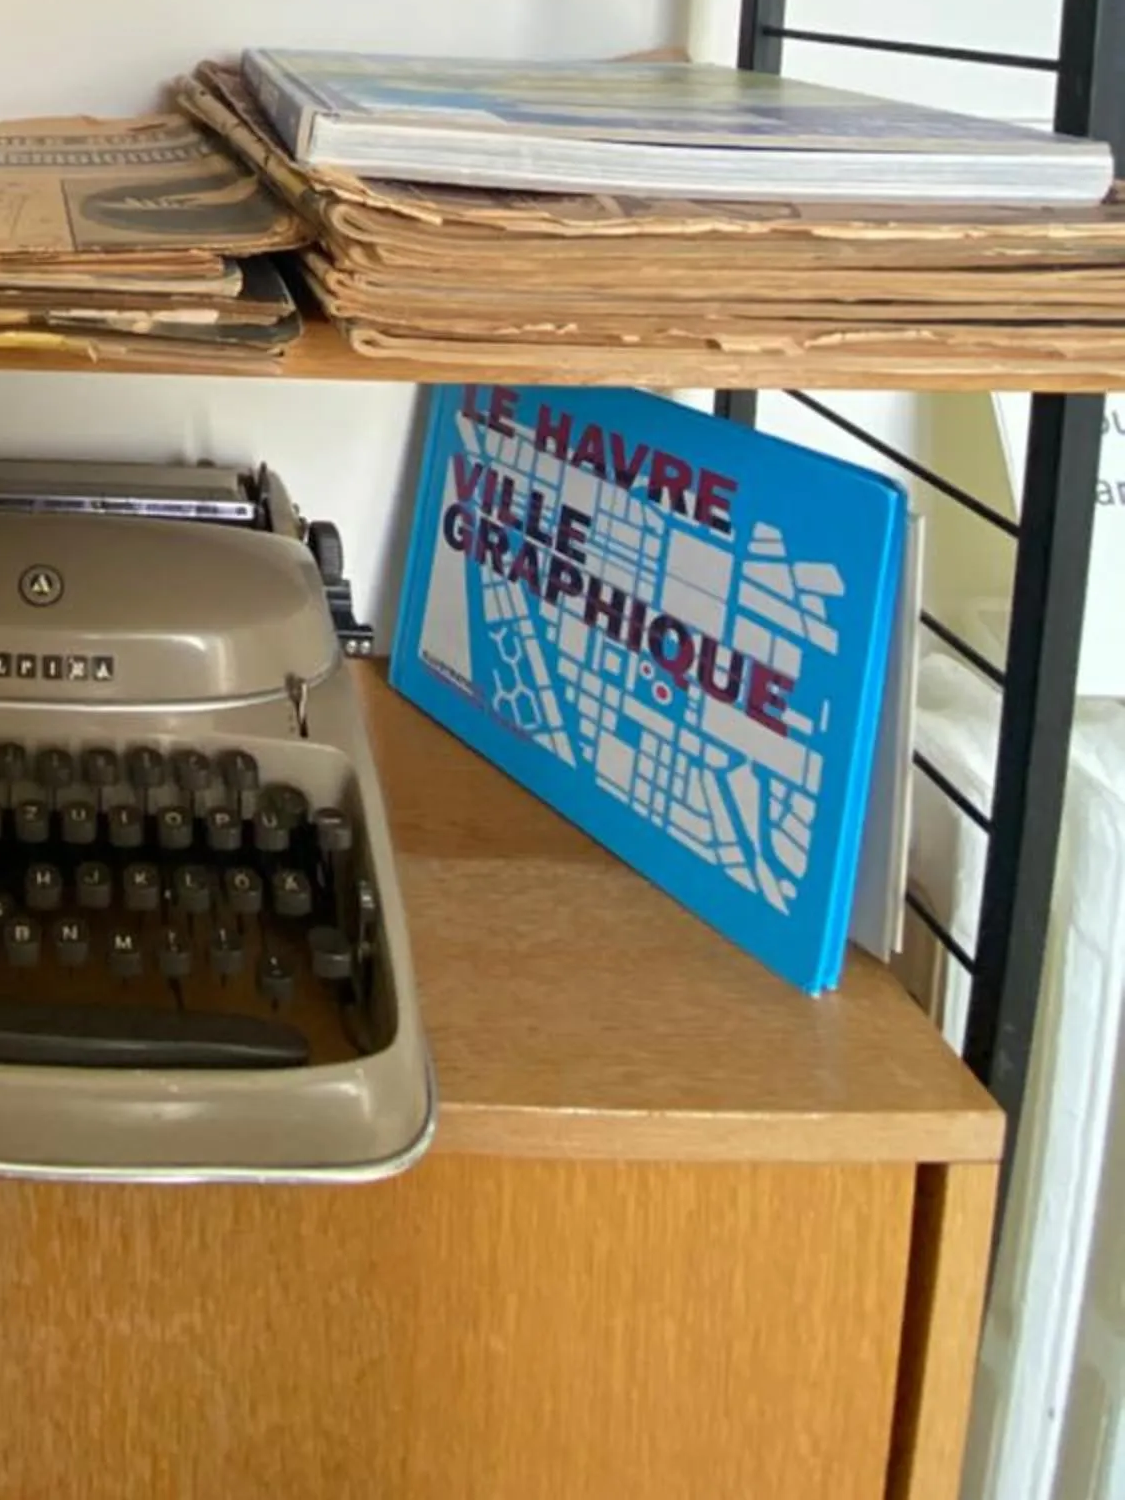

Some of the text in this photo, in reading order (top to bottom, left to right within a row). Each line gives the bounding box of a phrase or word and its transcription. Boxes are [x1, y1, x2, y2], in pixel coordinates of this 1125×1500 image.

[450, 453, 594, 563] VILLE
[460, 384, 738, 535] LE HAVRE
[441, 502, 797, 739] GRAPHIQUE
